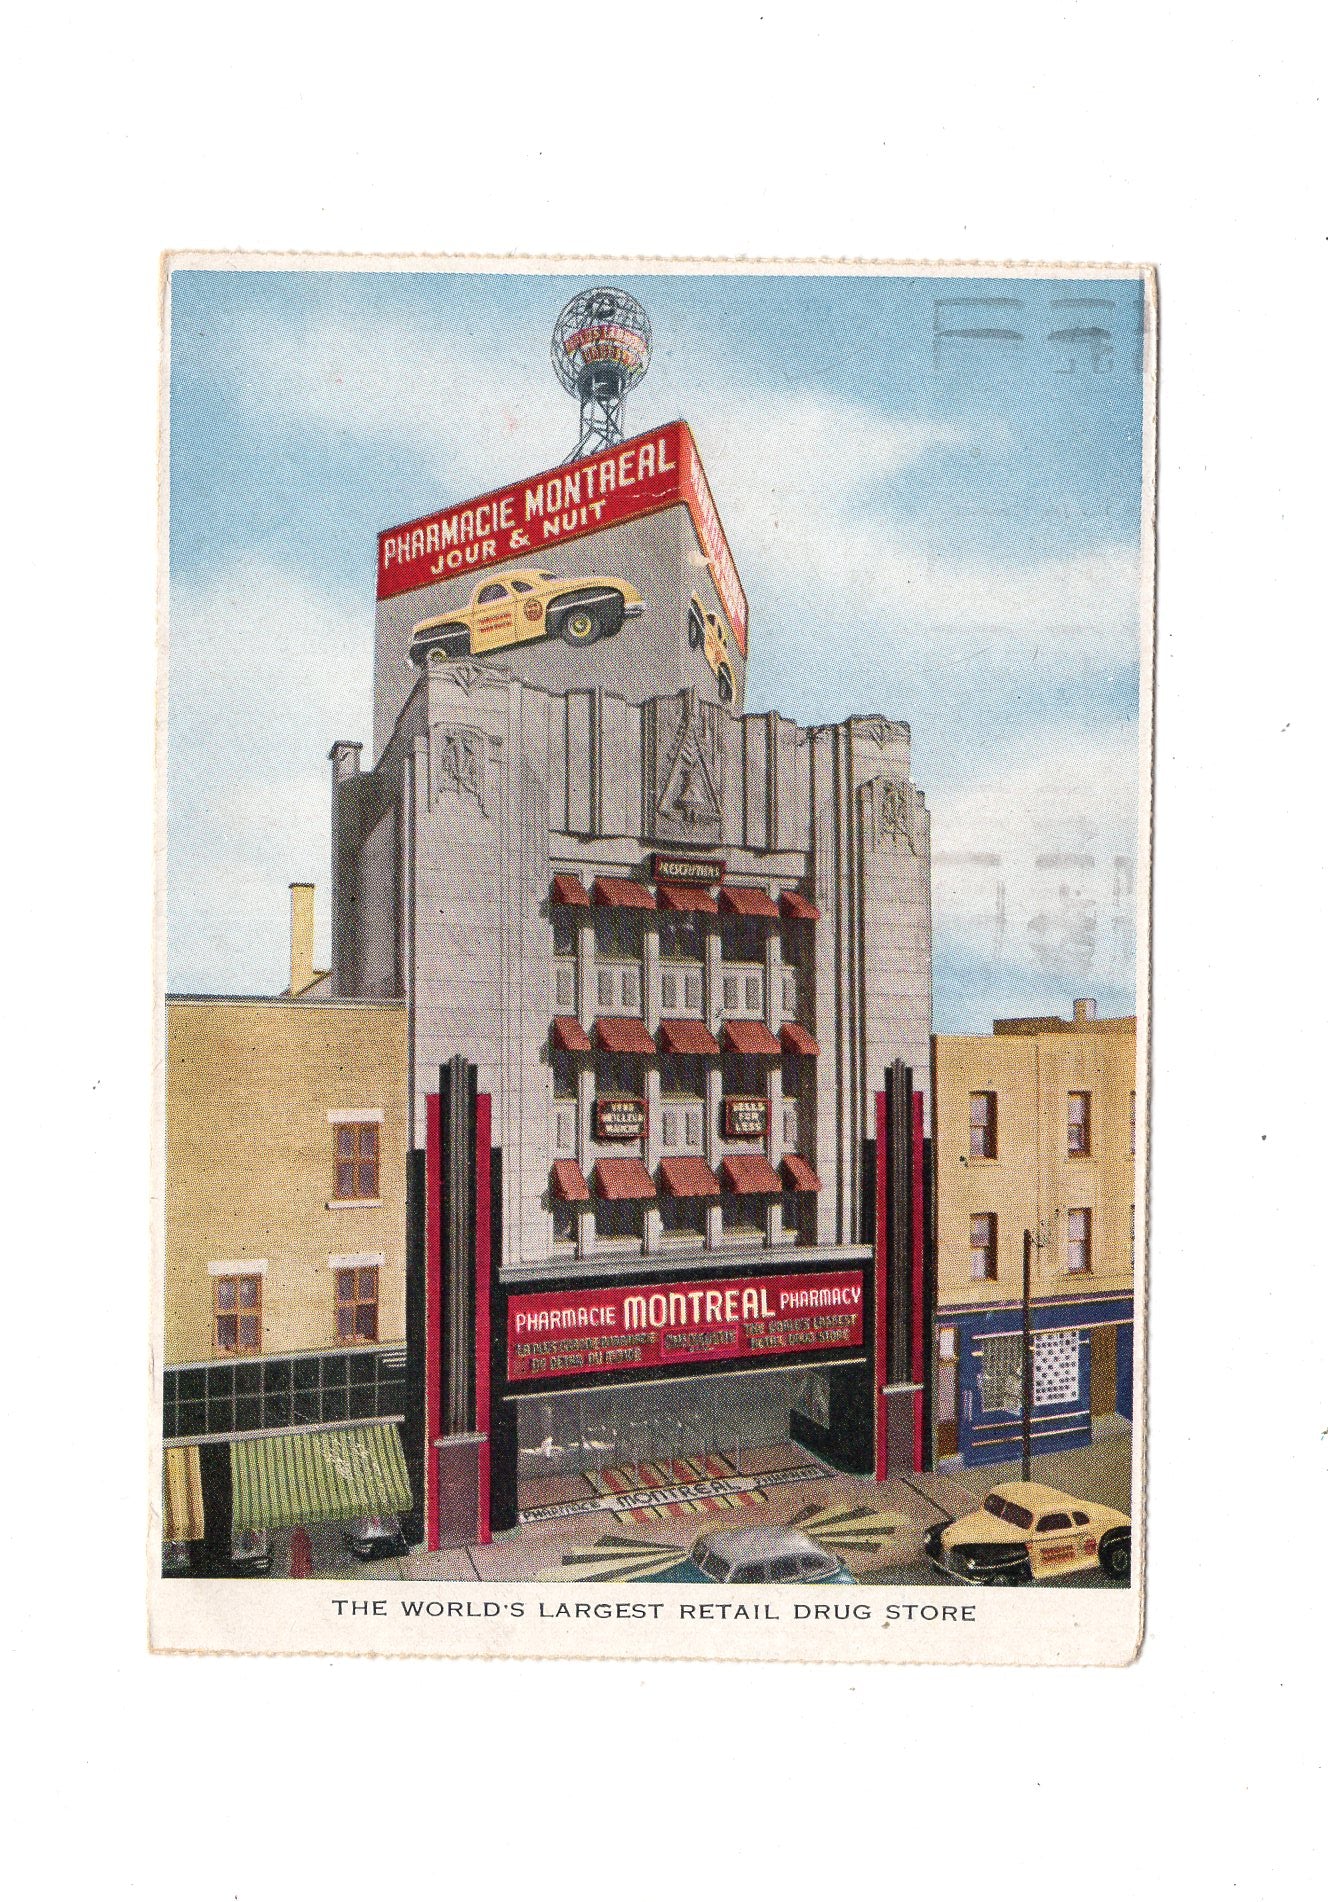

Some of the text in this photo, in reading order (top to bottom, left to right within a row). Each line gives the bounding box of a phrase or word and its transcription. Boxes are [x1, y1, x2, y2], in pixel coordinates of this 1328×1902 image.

[384, 438, 676, 569] PHARMACIE MONTREAL
[431, 500, 606, 575] JOUR & NUIT
[515, 1287, 861, 1333] PHARMACIE MONTREAL PHARMACY
[615, 1479, 740, 1507] MONTREAL
